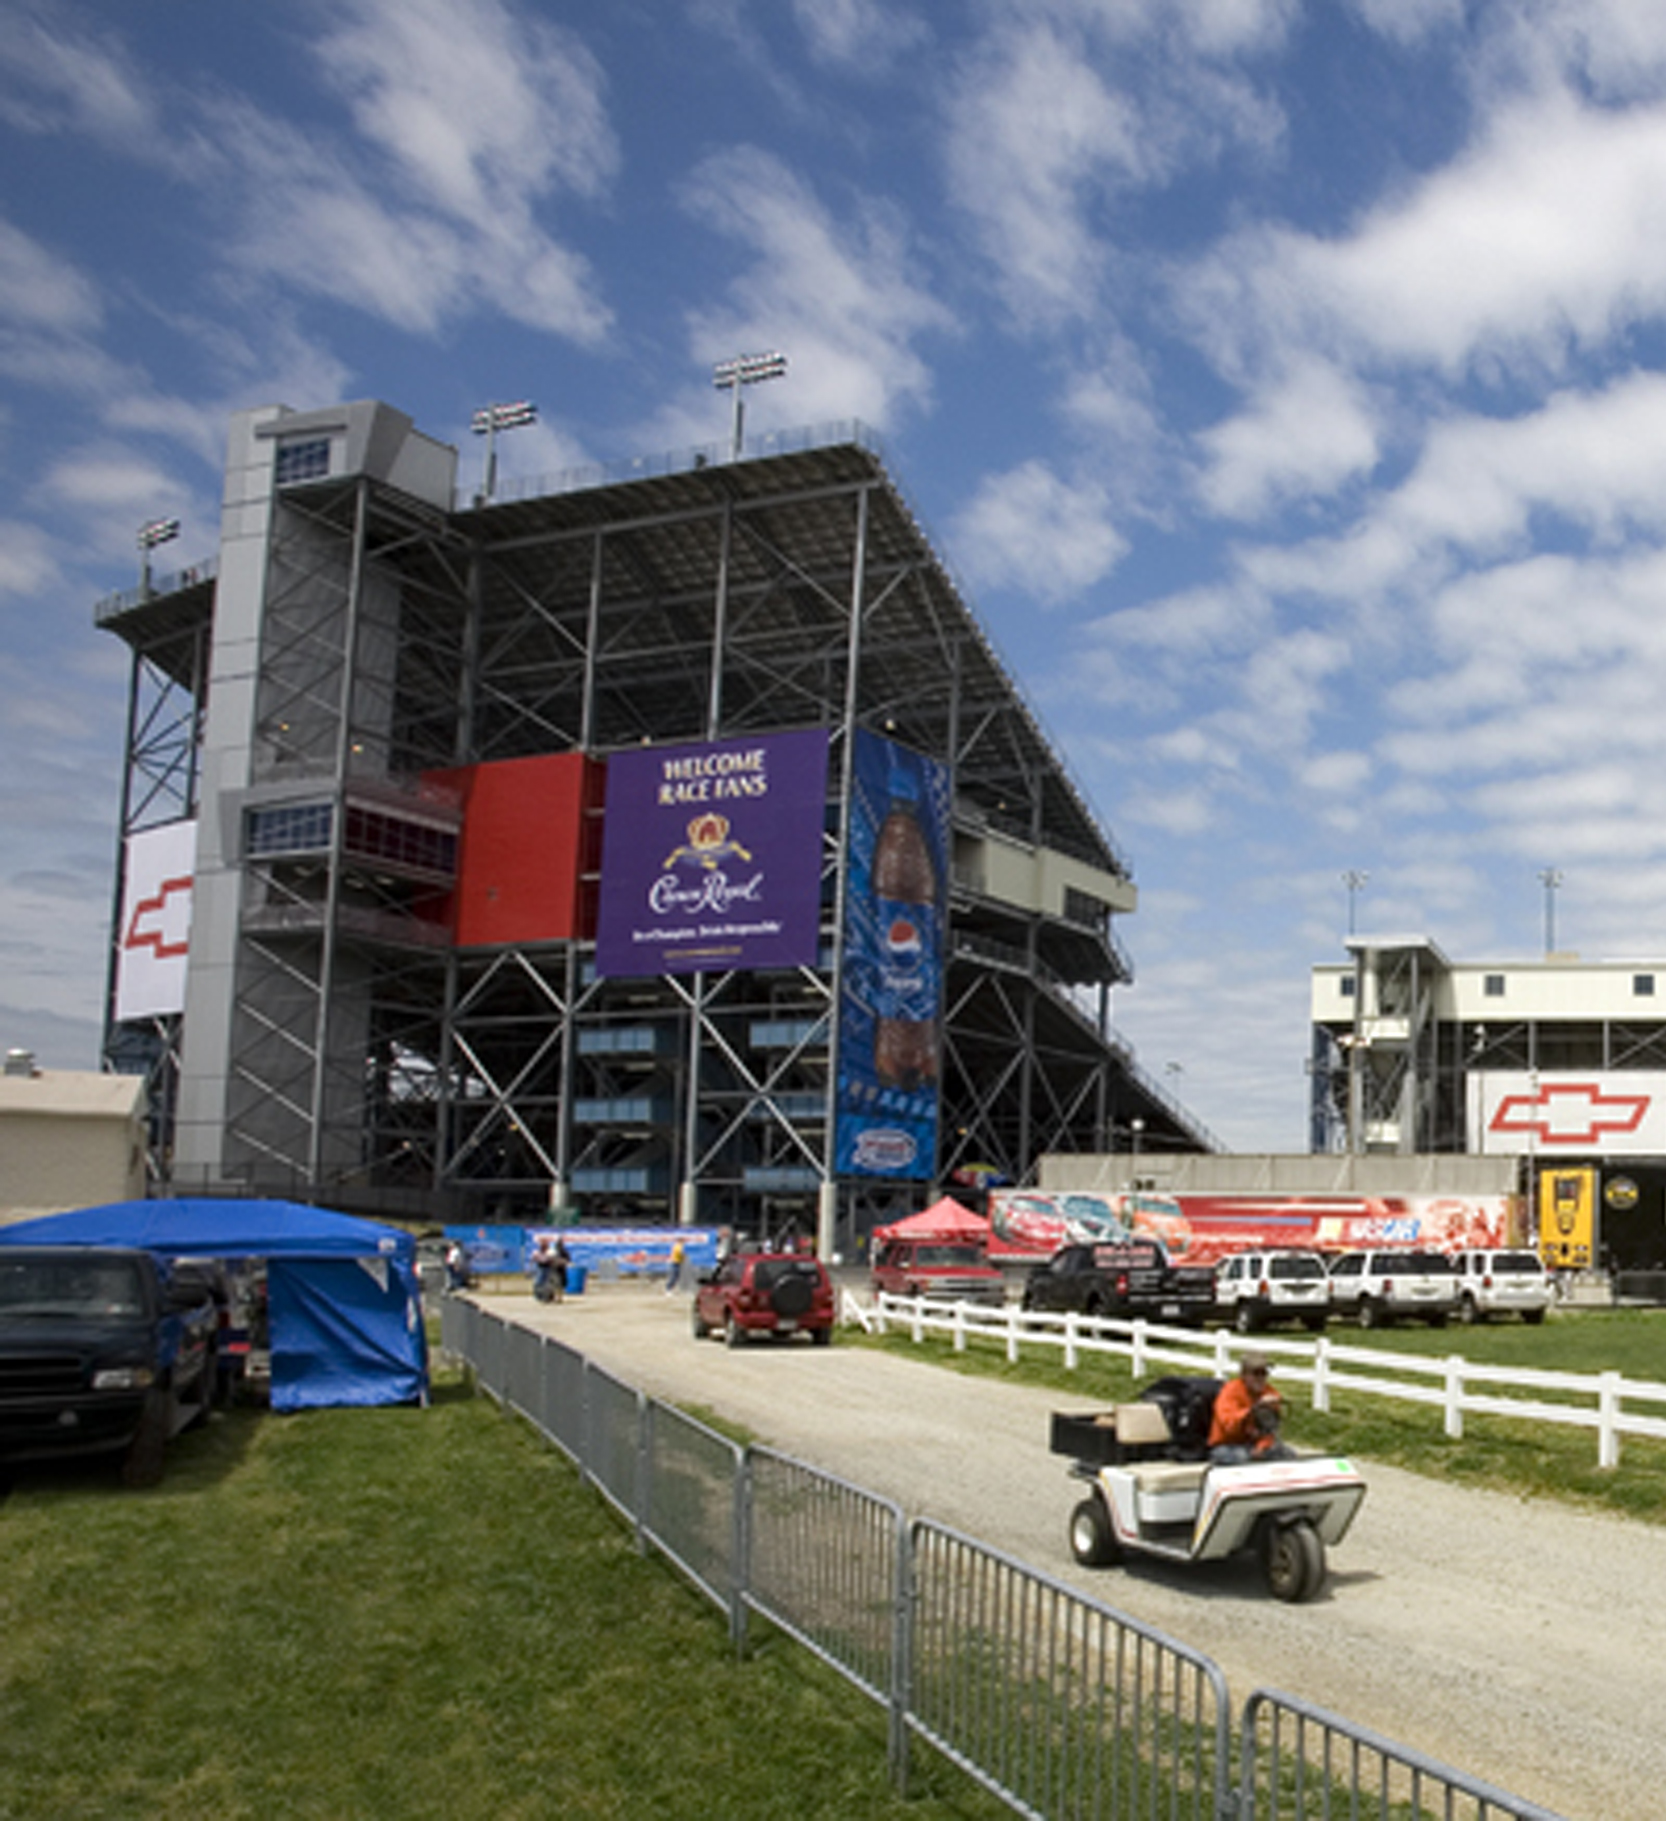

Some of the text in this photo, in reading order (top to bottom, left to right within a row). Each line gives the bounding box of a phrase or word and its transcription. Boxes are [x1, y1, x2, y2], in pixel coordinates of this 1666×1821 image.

[663, 748, 766, 780] WELCOME
[658, 775, 768, 805] RACE FANS
